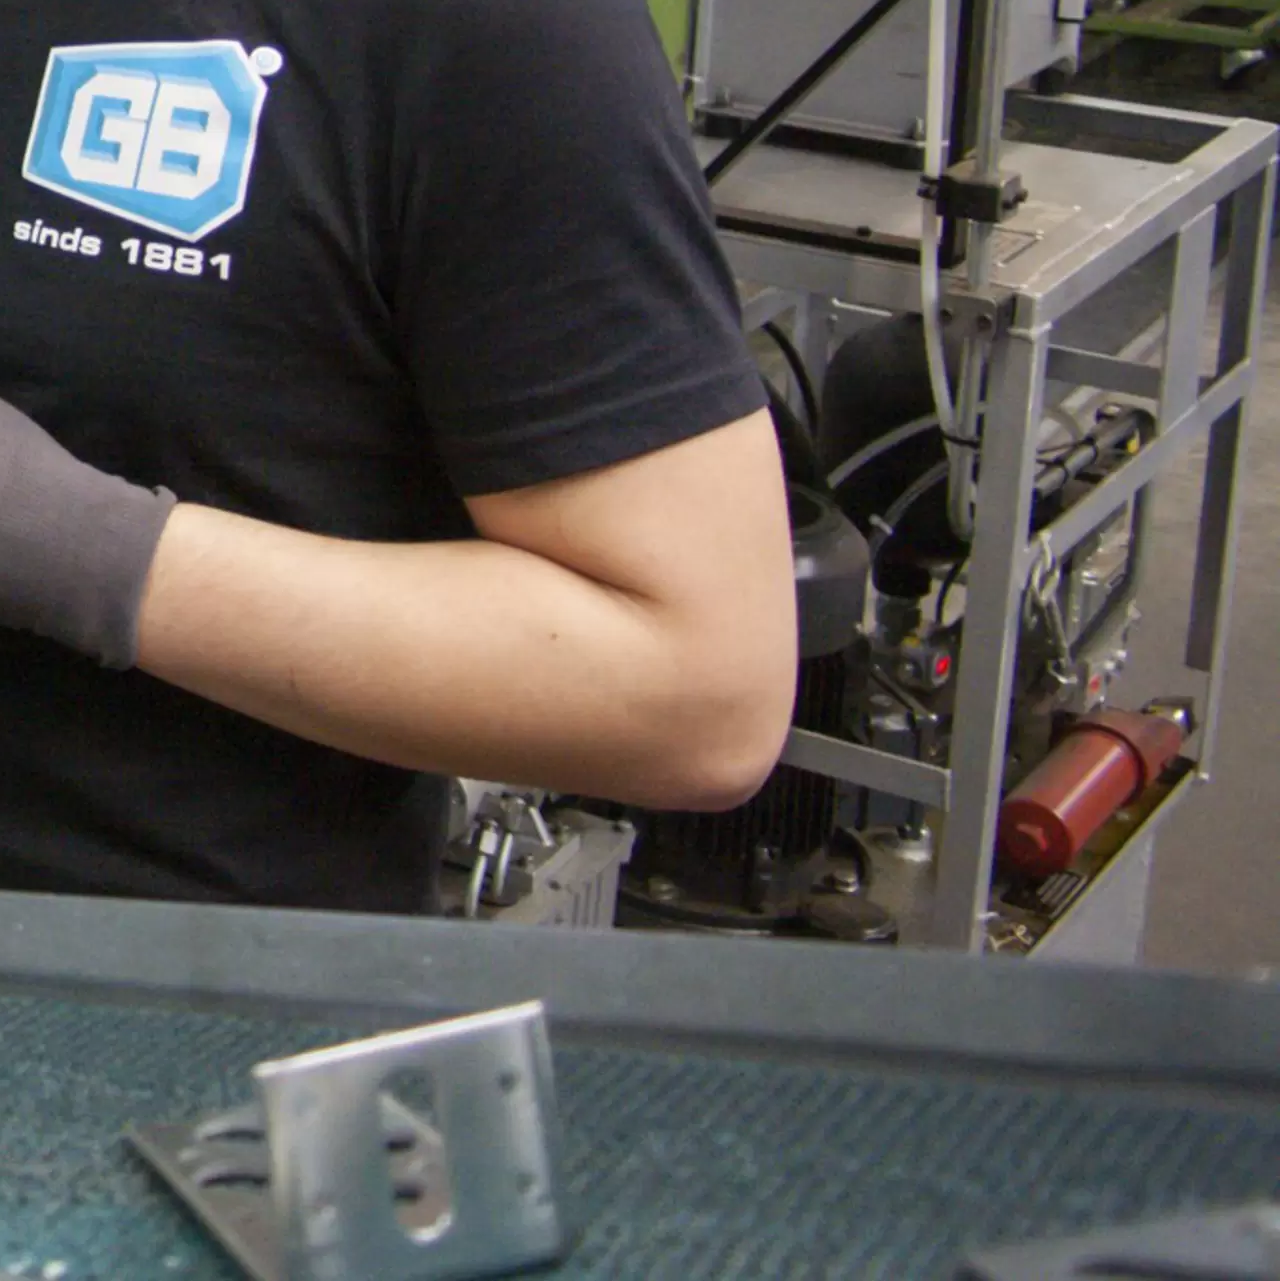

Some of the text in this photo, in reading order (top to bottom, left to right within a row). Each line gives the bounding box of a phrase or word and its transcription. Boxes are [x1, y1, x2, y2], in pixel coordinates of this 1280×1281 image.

[59, 65, 232, 201] GB
[12, 218, 232, 281] sinds 1881
